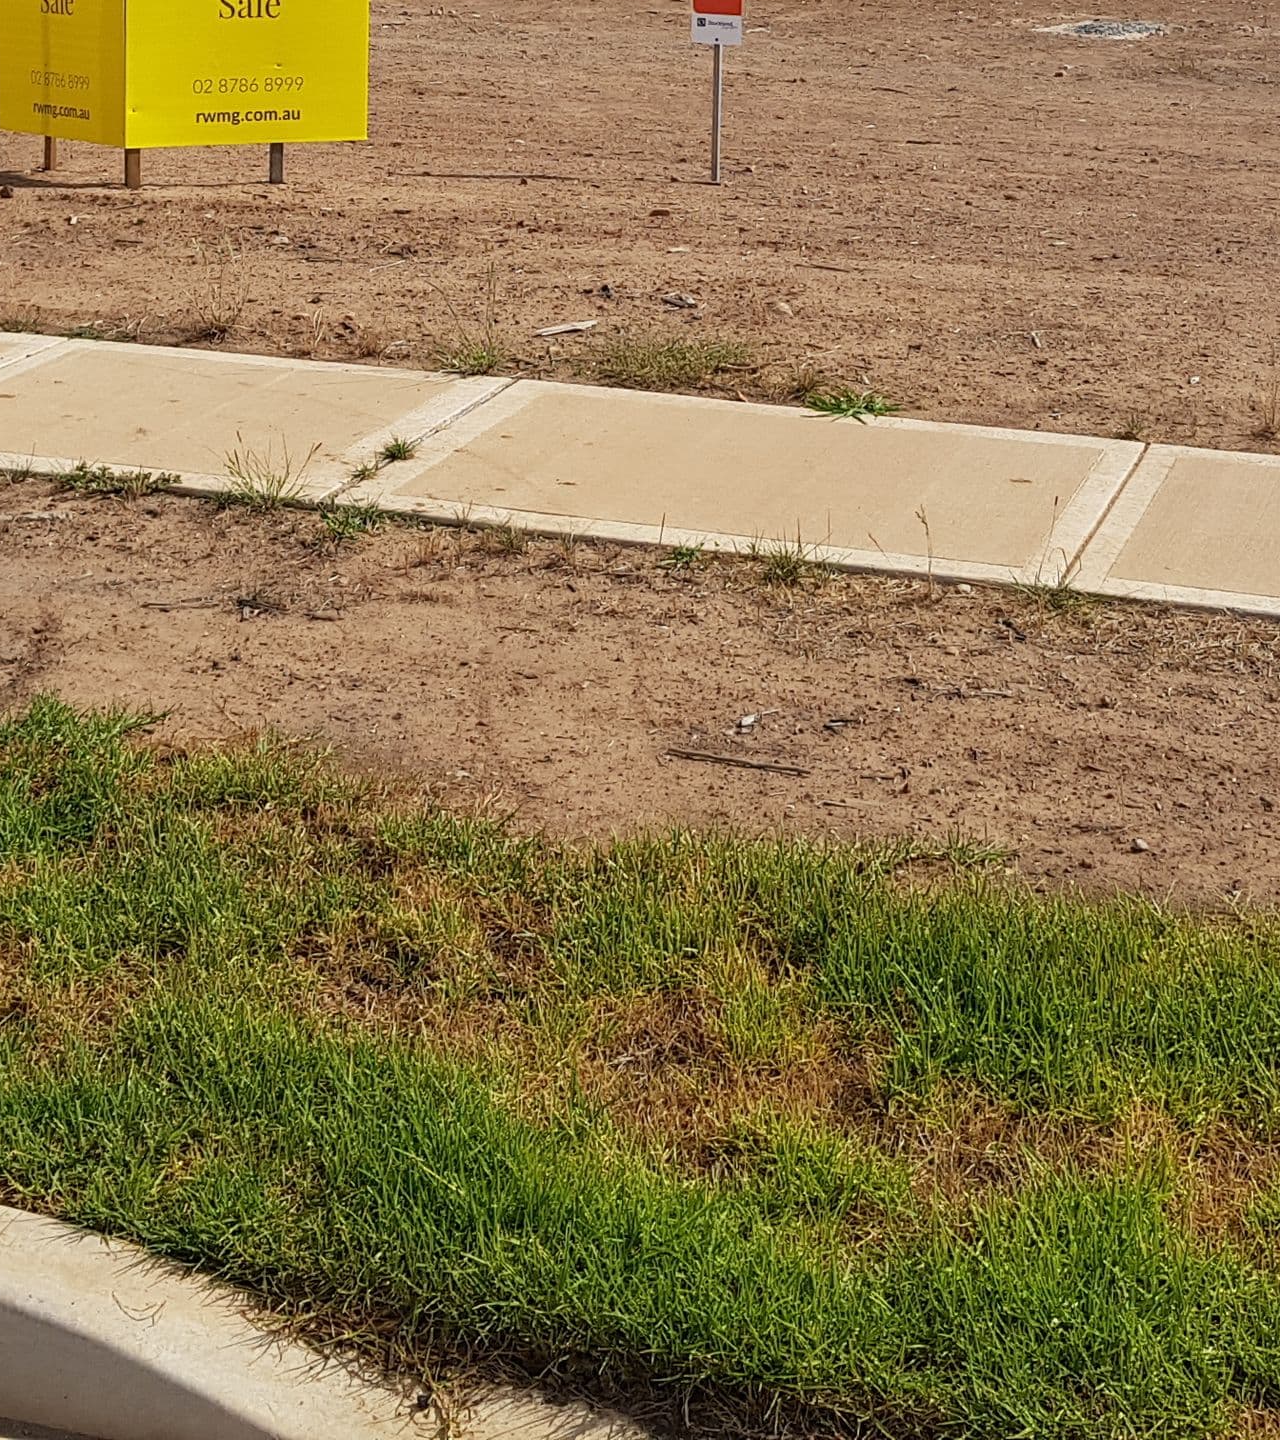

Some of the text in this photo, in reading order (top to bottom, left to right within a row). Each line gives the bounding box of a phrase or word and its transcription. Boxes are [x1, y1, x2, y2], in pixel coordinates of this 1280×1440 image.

[192, 76, 305, 94] 02 8786 8999
[32, 102, 90, 121] rwmg.com.au
[195, 109, 301, 125] rwmg.com.au
